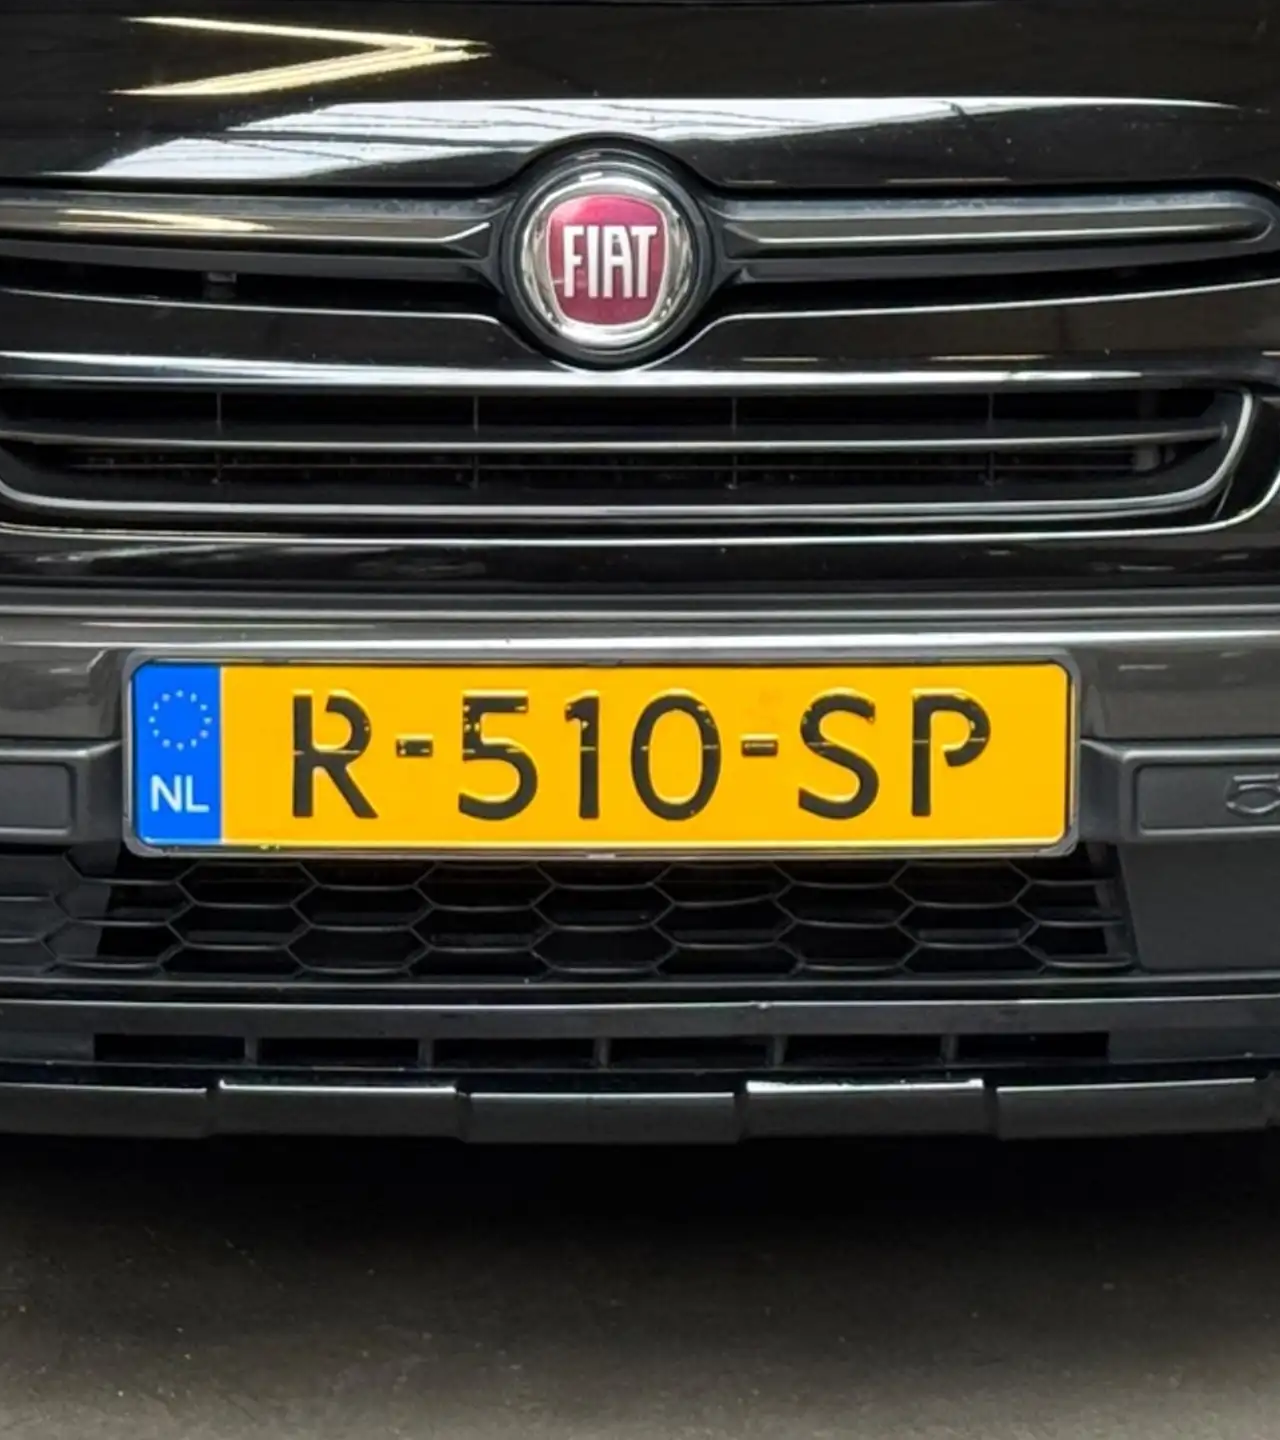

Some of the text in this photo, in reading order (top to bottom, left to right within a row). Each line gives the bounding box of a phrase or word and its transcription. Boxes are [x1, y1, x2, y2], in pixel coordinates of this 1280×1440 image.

[562, 224, 658, 299] FIAT
[291, 689, 992, 822] R-510-SP
[149, 776, 210, 814] NL
